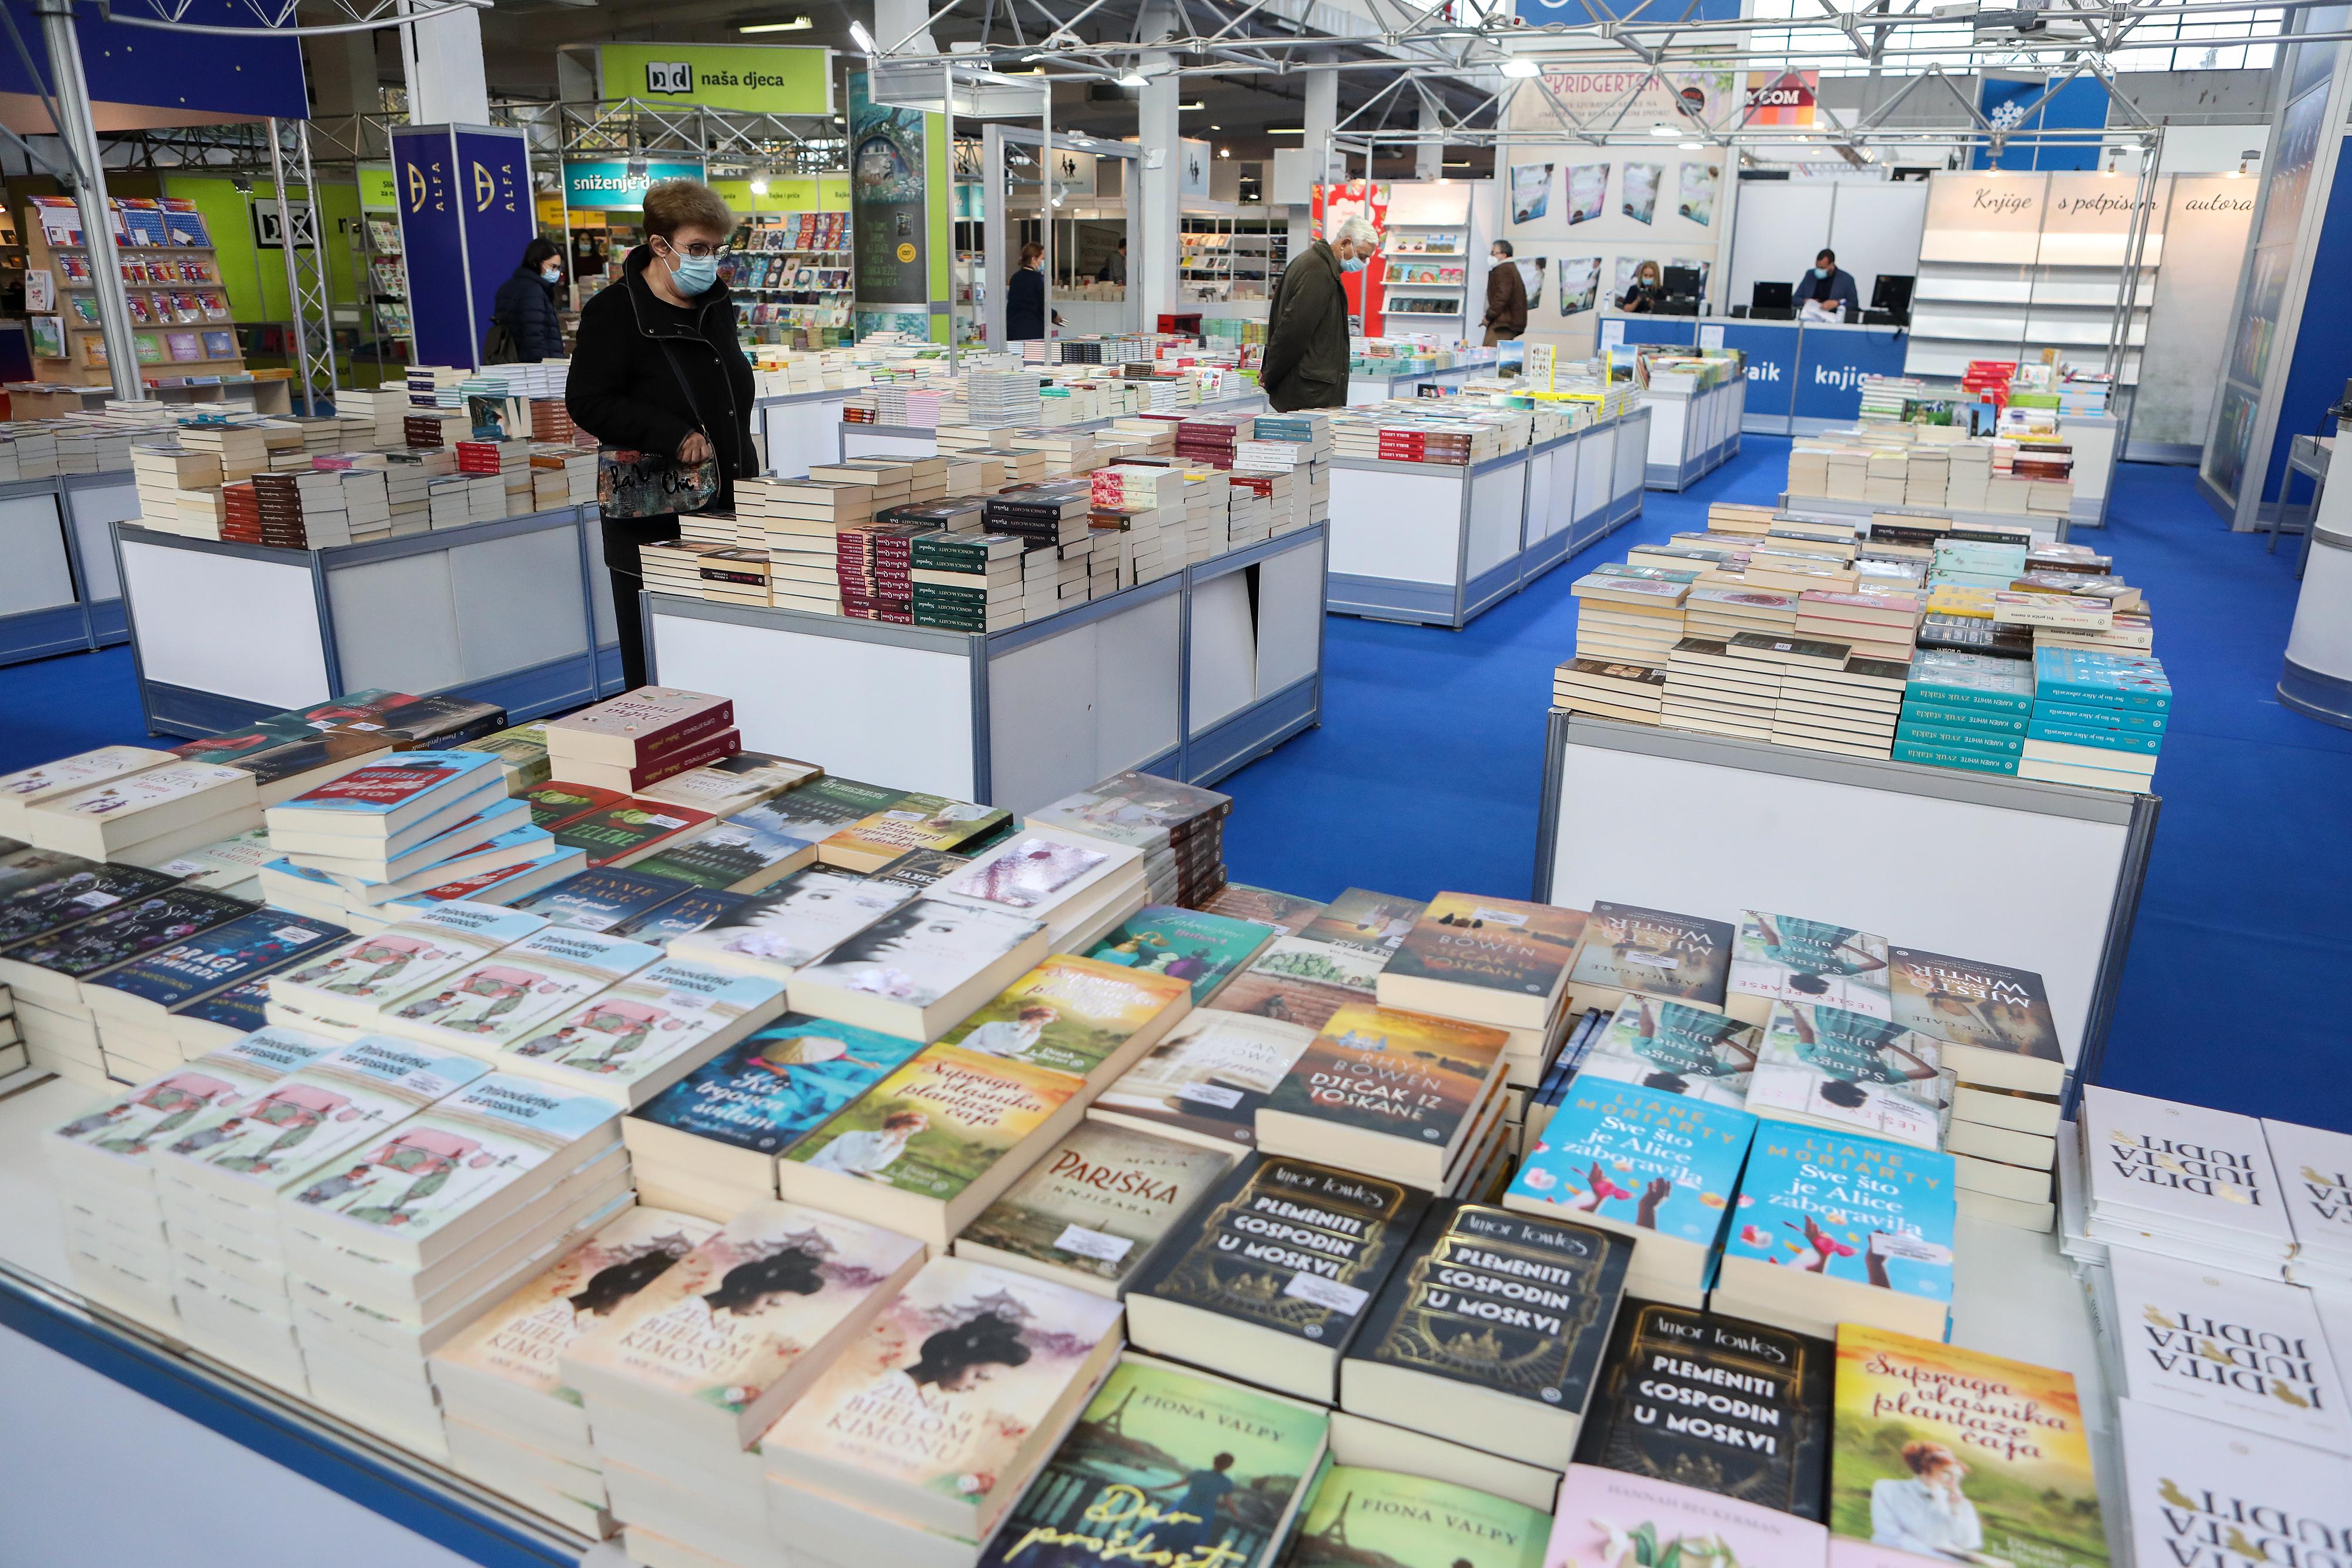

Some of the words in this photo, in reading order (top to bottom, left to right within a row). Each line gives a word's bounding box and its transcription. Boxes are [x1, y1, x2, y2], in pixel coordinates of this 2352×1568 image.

[701, 71, 739, 86] naša
[743, 70, 784, 89] djeca
[1760, 89, 1799, 105] COM
[432, 162, 444, 212] ALFA
[502, 164, 515, 212] ALFA
[573, 174, 637, 193] sniženje
[1973, 188, 2033, 214] Knjige
[2057, 196, 2067, 210] s
[2186, 194, 2255, 211] autora
[1815, 364, 1883, 392] knjig
[662, 472, 695, 495] Chic
[1920, 690, 1945, 699] stakla
[1916, 710, 1942, 719] stakla
[412, 736, 439, 751] predrasude
[442, 733, 457, 741] Ponos
[1912, 730, 1937, 738] stakla
[1908, 750, 1933, 758] stakla
[231, 847, 264, 858] OTOK
[1439, 935, 1536, 958] BOWEN
[1602, 930, 1712, 956] MJESTO
[1608, 917, 1713, 945] WINTER
[1787, 932, 1833, 948] ulice
[145, 954, 223, 980] EDWARDE
[161, 945, 249, 973] DRAGI
[1779, 955, 1828, 974] druge
[1783, 944, 1839, 960] strane
[1907, 963, 2029, 997] WINTER
[1910, 978, 2030, 1008] MJESTO
[1668, 1025, 1712, 1045] ulice
[1912, 1014, 1955, 1027] GALE
[1654, 1037, 1712, 1058] strane
[1816, 1042, 1880, 1064] strane
[1827, 1030, 1876, 1048] ulice
[922, 1060, 1022, 1092] Supruga
[1332, 1059, 1441, 1091] BOWEN
[1639, 1048, 1698, 1074] druge
[1808, 1055, 1870, 1078] druge
[941, 1076, 1043, 1114] vlasnika
[1309, 1071, 1410, 1102] DJEČAK
[1417, 1094, 1442, 1109] IZ
[1310, 1085, 1427, 1121] TOSKANE
[945, 1103, 998, 1127] čaja
[1576, 1098, 1735, 1145] MORIARTY
[1614, 1093, 1706, 1124] LIANE
[1849, 1105, 1917, 1133] LESLEY
[1587, 1127, 1613, 1146] je
[1618, 1134, 1693, 1165] Alice
[1601, 1115, 1646, 1135] Sve
[1652, 1126, 1694, 1149] što
[1123, 1157, 1189, 1167] MALA
[1561, 1140, 1703, 1186] zaboravila
[1766, 1142, 1940, 1191] MORIARTY
[1805, 1137, 1904, 1168] LIANE
[1048, 1148, 1179, 1205] PARIŠKA
[1799, 1163, 1849, 1185] Sve
[1856, 1174, 1900, 1196] što
[1053, 1185, 1152, 1216] KNJIŽARA
[1785, 1178, 1813, 1198] je
[1825, 1182, 1904, 1212] Alice
[1254, 1196, 1364, 1236] PLEMENITI
[1767, 1190, 1925, 1238] zaboravila
[1233, 1214, 1354, 1258] GOSPODIN
[1217, 1234, 1240, 1252] U
[1244, 1238, 1340, 1278] MOSKVI
[1454, 1245, 1571, 1287] PLEMENITI
[1438, 1266, 1570, 1310] GOSPODIN
[1428, 1288, 1446, 1309] U
[1455, 1295, 1561, 1338] MOSKVI
[619, 1331, 739, 1375] KIMONU
[637, 1316, 751, 1363] BIJELOM
[1652, 1355, 1775, 1399] PLEMENITI
[1866, 1353, 2013, 1399] Supruga
[1140, 1393, 1208, 1423] FIONA
[1215, 1413, 1286, 1443] VALPY
[1639, 1379, 1780, 1427] GOSPODIN
[1873, 1392, 2027, 1438] plantaže
[1917, 1382, 2067, 1431] vlasnika
[844, 1395, 974, 1446] BIJELOM
[1634, 1405, 1657, 1425] U
[1665, 1409, 1776, 1455] MOSKVI
[826, 1412, 964, 1462] KIMONU
[1960, 1430, 2042, 1461] čaja
[1085, 1484, 1204, 1525] Dar
[1361, 1497, 1434, 1523] FIONA
[1446, 1515, 1520, 1547] VALPY
